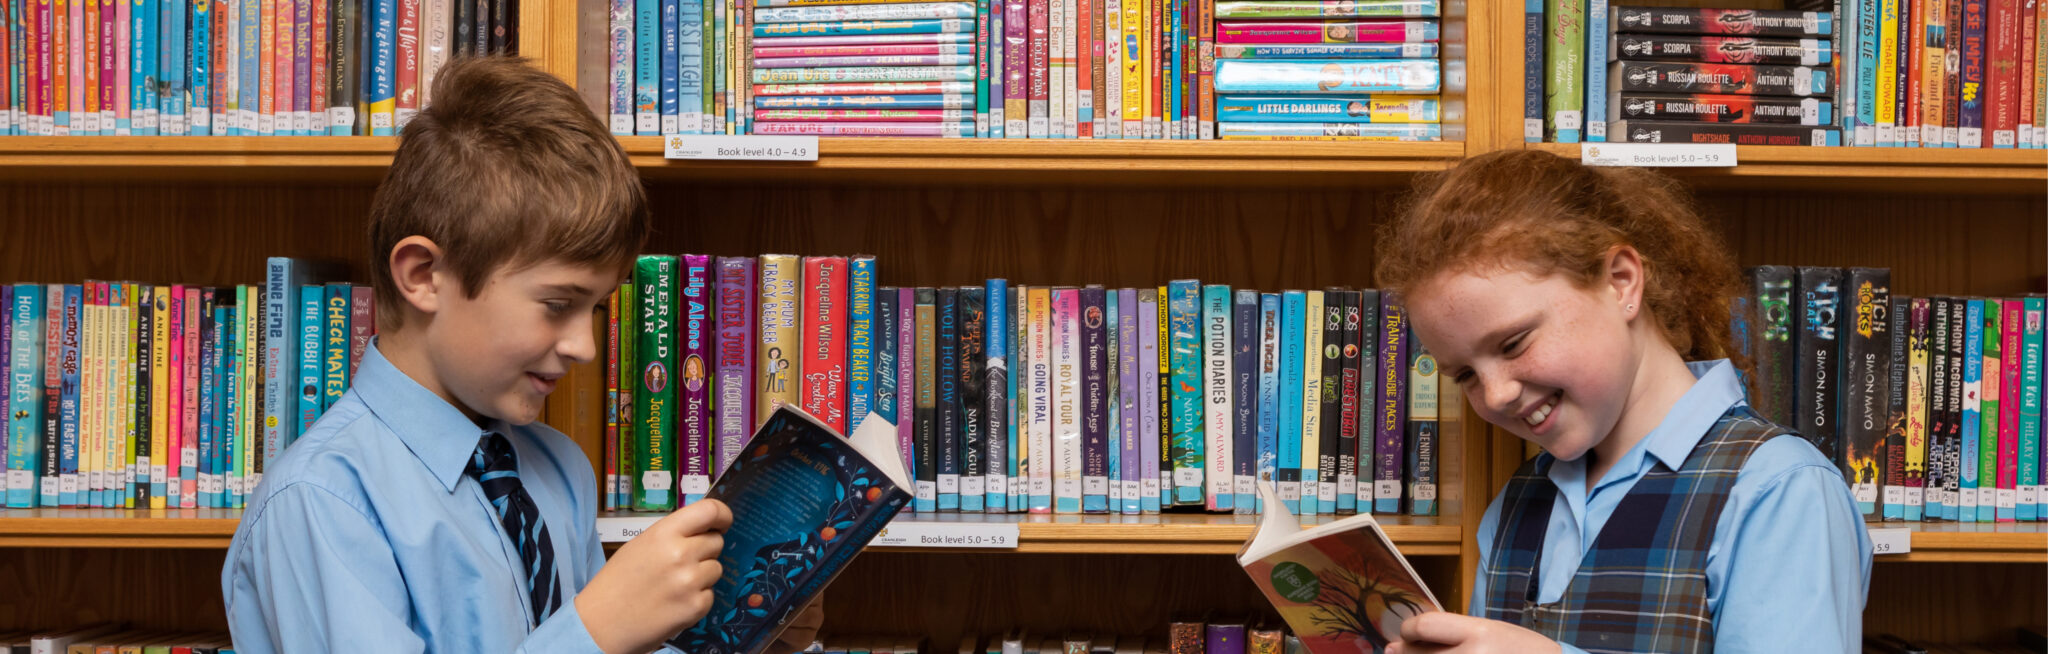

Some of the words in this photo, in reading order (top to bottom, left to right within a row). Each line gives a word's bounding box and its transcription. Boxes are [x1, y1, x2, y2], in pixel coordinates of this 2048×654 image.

[682, 2, 700, 47] FIRST
[1053, 12, 1061, 23] for
[1662, 14, 1690, 24] SCORPIA
[1753, 17, 1785, 28] ANTHONY
[337, 17, 346, 56] EDWARD
[398, 27, 418, 70] Ulysses
[616, 29, 626, 68] NICKY
[1051, 27, 1062, 51] Bear
[1594, 23, 1603, 61] Belinda
[1664, 44, 1691, 53] SCORPIA
[1753, 46, 1786, 56] ANTHONY
[1863, 41, 1873, 60] LIE
[375, 18, 390, 94] Nightingale
[1884, 38, 1893, 73] CHARLI
[1931, 54, 1941, 77] Fire
[1966, 37, 1980, 82] IMPEY
[336, 58, 345, 91] TULANE
[616, 70, 626, 113] SINGER
[681, 55, 700, 98] LIGHT
[761, 69, 798, 81] Jean
[803, 69, 830, 81] Ure
[1592, 66, 1602, 105] Hollyer
[1668, 72, 1696, 83] RUSSIAN
[1696, 74, 1729, 84] ROULETTE
[1757, 76, 1787, 85] ANTHONY
[1864, 67, 1872, 87] POLLY
[1930, 80, 1939, 100] and
[1999, 80, 2008, 101] ANNA
[1257, 104, 1291, 114] LITTLE
[1292, 104, 1342, 114] DARLINGS
[1666, 102, 1694, 113] RUSSIAN
[1696, 104, 1727, 114] ROULETTE
[1755, 105, 1788, 115] ANTHONY
[1882, 76, 1892, 120] HOWARD
[1929, 104, 1939, 121] Ice
[1998, 102, 2006, 128] JAMES
[763, 124, 796, 133] JEAN
[800, 124, 824, 133] URE
[1692, 134, 1730, 143] NIGHTSHADE
[1738, 134, 1766, 144] ANTHONY
[1768, 136, 1800, 145] HOROWITZ
[718, 148, 741, 156] Book
[744, 147, 764, 156] level
[767, 148, 782, 156] 4.0
[792, 148, 806, 157] 4.9
[1658, 154, 1679, 162] level
[683, 267, 704, 301] Lily
[722, 268, 745, 284] MY
[763, 263, 777, 298] TRACY
[781, 280, 794, 295] MY
[816, 263, 833, 322] Jacqueline
[853, 270, 870, 315] STARRING
[17, 295, 32, 326] HOUR
[305, 300, 318, 321] THE
[644, 284, 655, 334] STAR
[658, 261, 668, 358] EMERALD
[722, 288, 744, 327] SISTER
[781, 300, 794, 328] MUM
[991, 287, 999, 313] ALLAN
[1212, 297, 1222, 313] THE
[1806, 292, 1815, 332] CRAFT
[1860, 288, 1871, 331] ROCKS
[17, 330, 29, 344] OF
[64, 306, 79, 347] memory
[328, 297, 345, 345] CHECK
[688, 302, 704, 350] Alone
[763, 303, 777, 343] BEAKER
[853, 319, 869, 347] TRACY
[942, 303, 954, 340] WOLF
[991, 314, 999, 350] AHLBERG
[1211, 316, 1224, 357] POTION
[1264, 310, 1274, 342] TIGER
[1386, 314, 1401, 345] TRAIN
[1894, 303, 1907, 362] Tamburlaine's
[1935, 301, 1946, 352] ANTHONY
[1952, 304, 1962, 353] ANTHONY
[16, 345, 30, 369] THE
[303, 325, 318, 371] BUBBLE
[722, 332, 744, 367] JODIE
[818, 324, 832, 360] Wilson
[1264, 343, 1274, 374] TIGER
[63, 350, 78, 375] cage
[327, 348, 344, 397] MATES
[852, 348, 869, 382] BEAKER
[877, 351, 895, 387] Bright
[942, 345, 954, 404] HOLLOW
[1035, 364, 1046, 393] GOING
[1386, 351, 1397, 397] IMPOSSIBLE
[1816, 350, 1826, 389] SIMON
[1865, 354, 1875, 394] SIMON
[16, 373, 32, 403] BEES
[806, 372, 824, 415] Goodbye
[827, 364, 841, 399] Wave
[1060, 364, 1072, 397] ROYAL
[1211, 360, 1226, 404] DIARIES
[1263, 376, 1272, 407] LYNNE
[1306, 379, 1318, 412] Media
[1892, 364, 1904, 406] Elephants
[1933, 355, 1944, 410] McGOWAN
[1950, 357, 1961, 413] McGOWAN
[723, 375, 743, 434] JACQUELINE
[828, 402, 841, 423] Me
[1035, 396, 1046, 425] VIRAL
[1061, 400, 1072, 425] TOUR
[1184, 397, 1192, 432] NADIA
[1216, 411, 1224, 430] AMY
[1386, 400, 1396, 431] PLACES
[1815, 392, 1824, 427] MAYO
[1864, 395, 1873, 430] MAYO
[646, 398, 663, 455] Jacqueline
[684, 397, 702, 454] Jacqueline
[968, 408, 976, 443] NADIA
[989, 421, 1000, 459] Burglar
[1306, 416, 1316, 438] Star
[1968, 414, 1976, 437] Karen
[2024, 422, 2034, 459] HILARY
[1216, 432, 1224, 472] ALWARD
[1262, 436, 1270, 469] BANKS
[1327, 456, 1335, 477] COLIN
[1419, 432, 1431, 472] JENNIFER
[921, 536, 942, 544] Book
[945, 536, 965, 544] level
